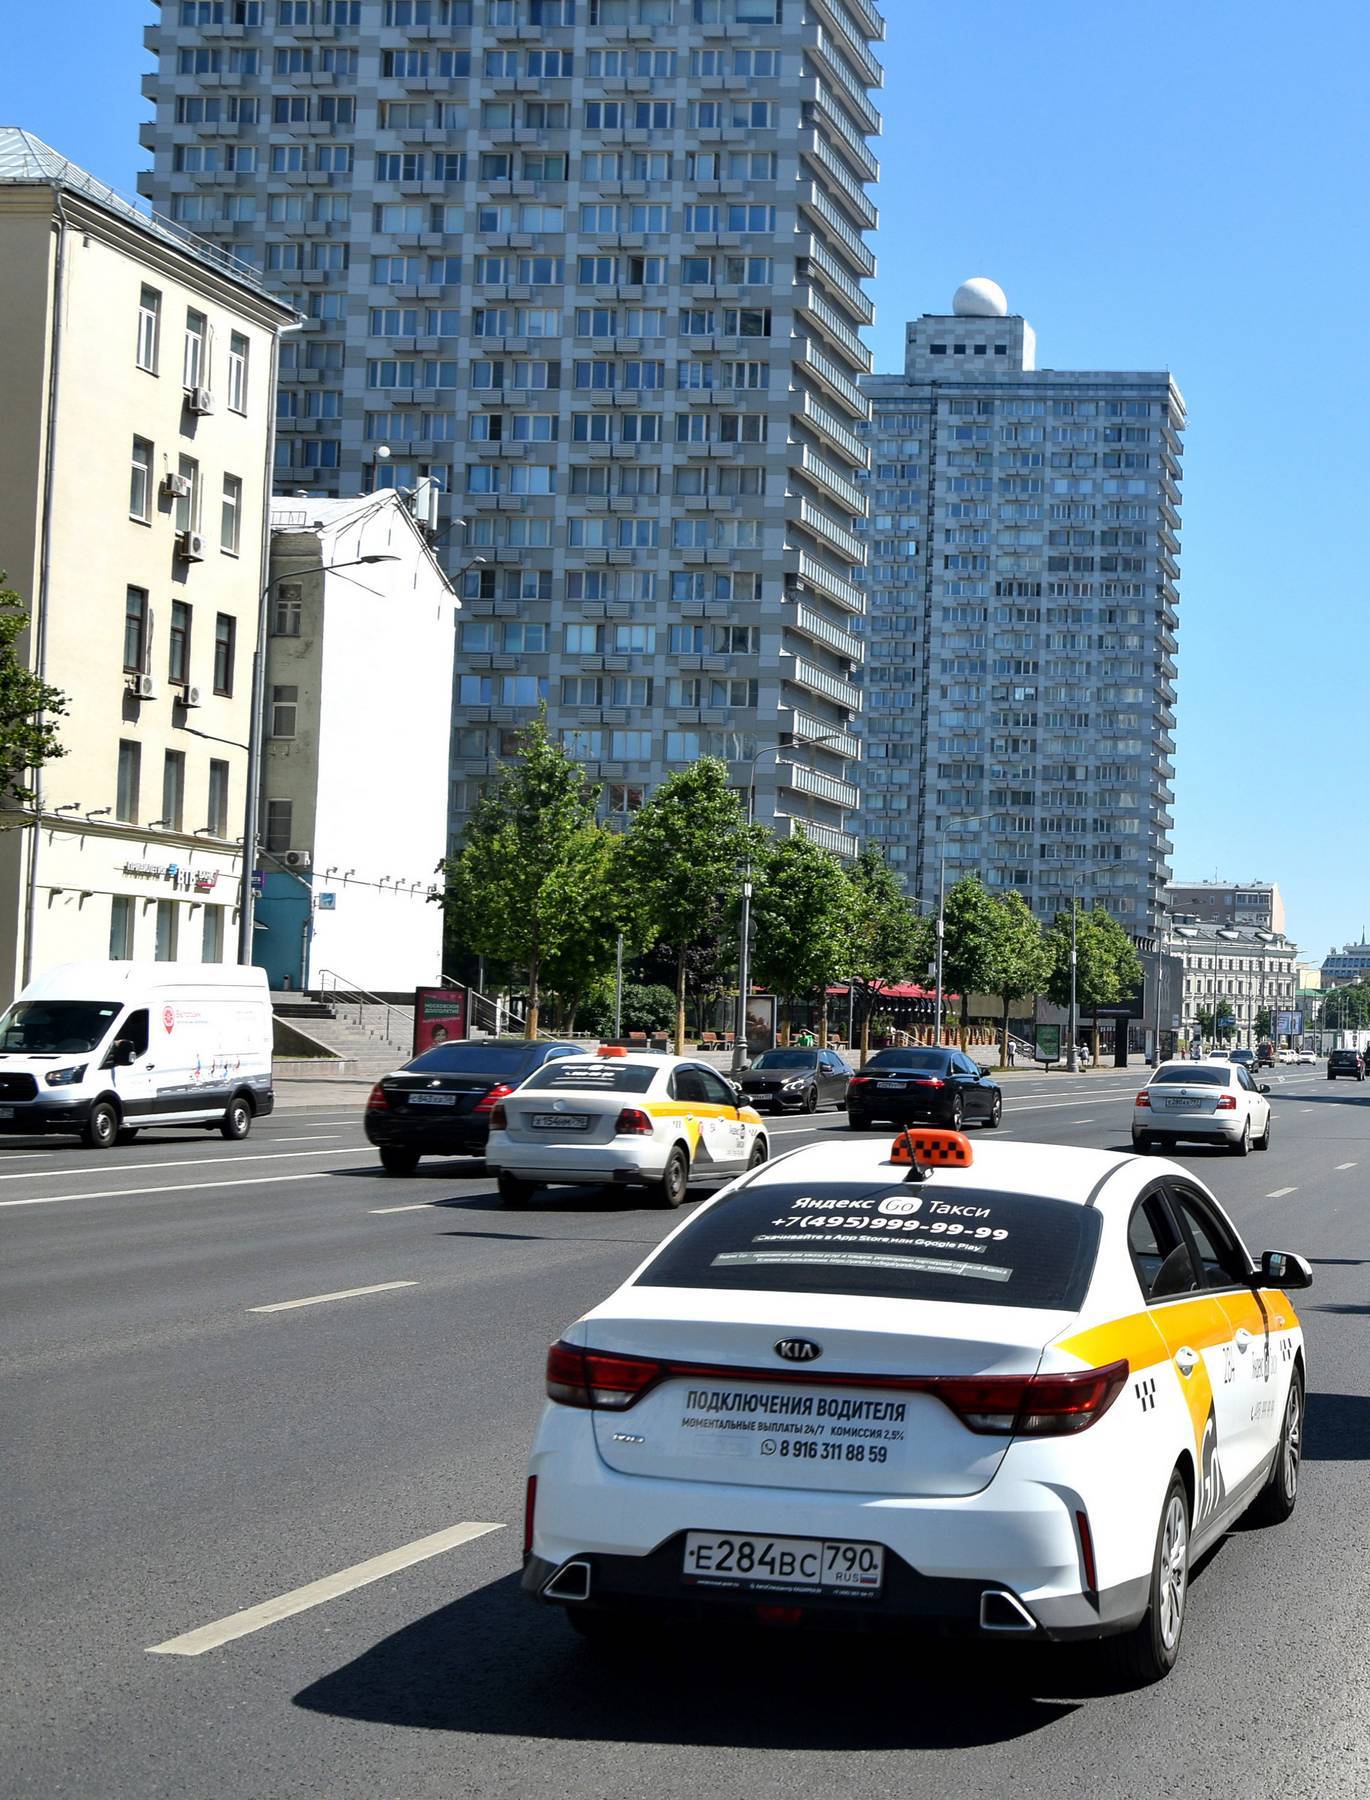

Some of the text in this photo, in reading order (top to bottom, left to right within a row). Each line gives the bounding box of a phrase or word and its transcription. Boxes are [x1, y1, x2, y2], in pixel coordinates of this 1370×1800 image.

[791, 1197, 876, 1209] Яндекс
[928, 1200, 991, 1218] Такси
[770, 1215, 1009, 1241] +7(495)999-99-99
[832, 1234, 858, 1242] App
[781, 1341, 814, 1358] KIA
[686, 1390, 906, 1422] ПОДКЛЮЧЕНИЯ ВОДИТЕЛЯ
[681, 1417, 756, 1431] МОМЕНТАЛЬНЫЕ
[757, 1421, 802, 1434] ВЫПЛАТЫ
[803, 1424, 825, 1436] 24/7
[830, 1426, 883, 1439] КОМИССИЯ
[780, 1442, 888, 1463] 8 916 311 88 59
[825, 1544, 874, 1573] 790
[835, 1571, 859, 1583] RUS
